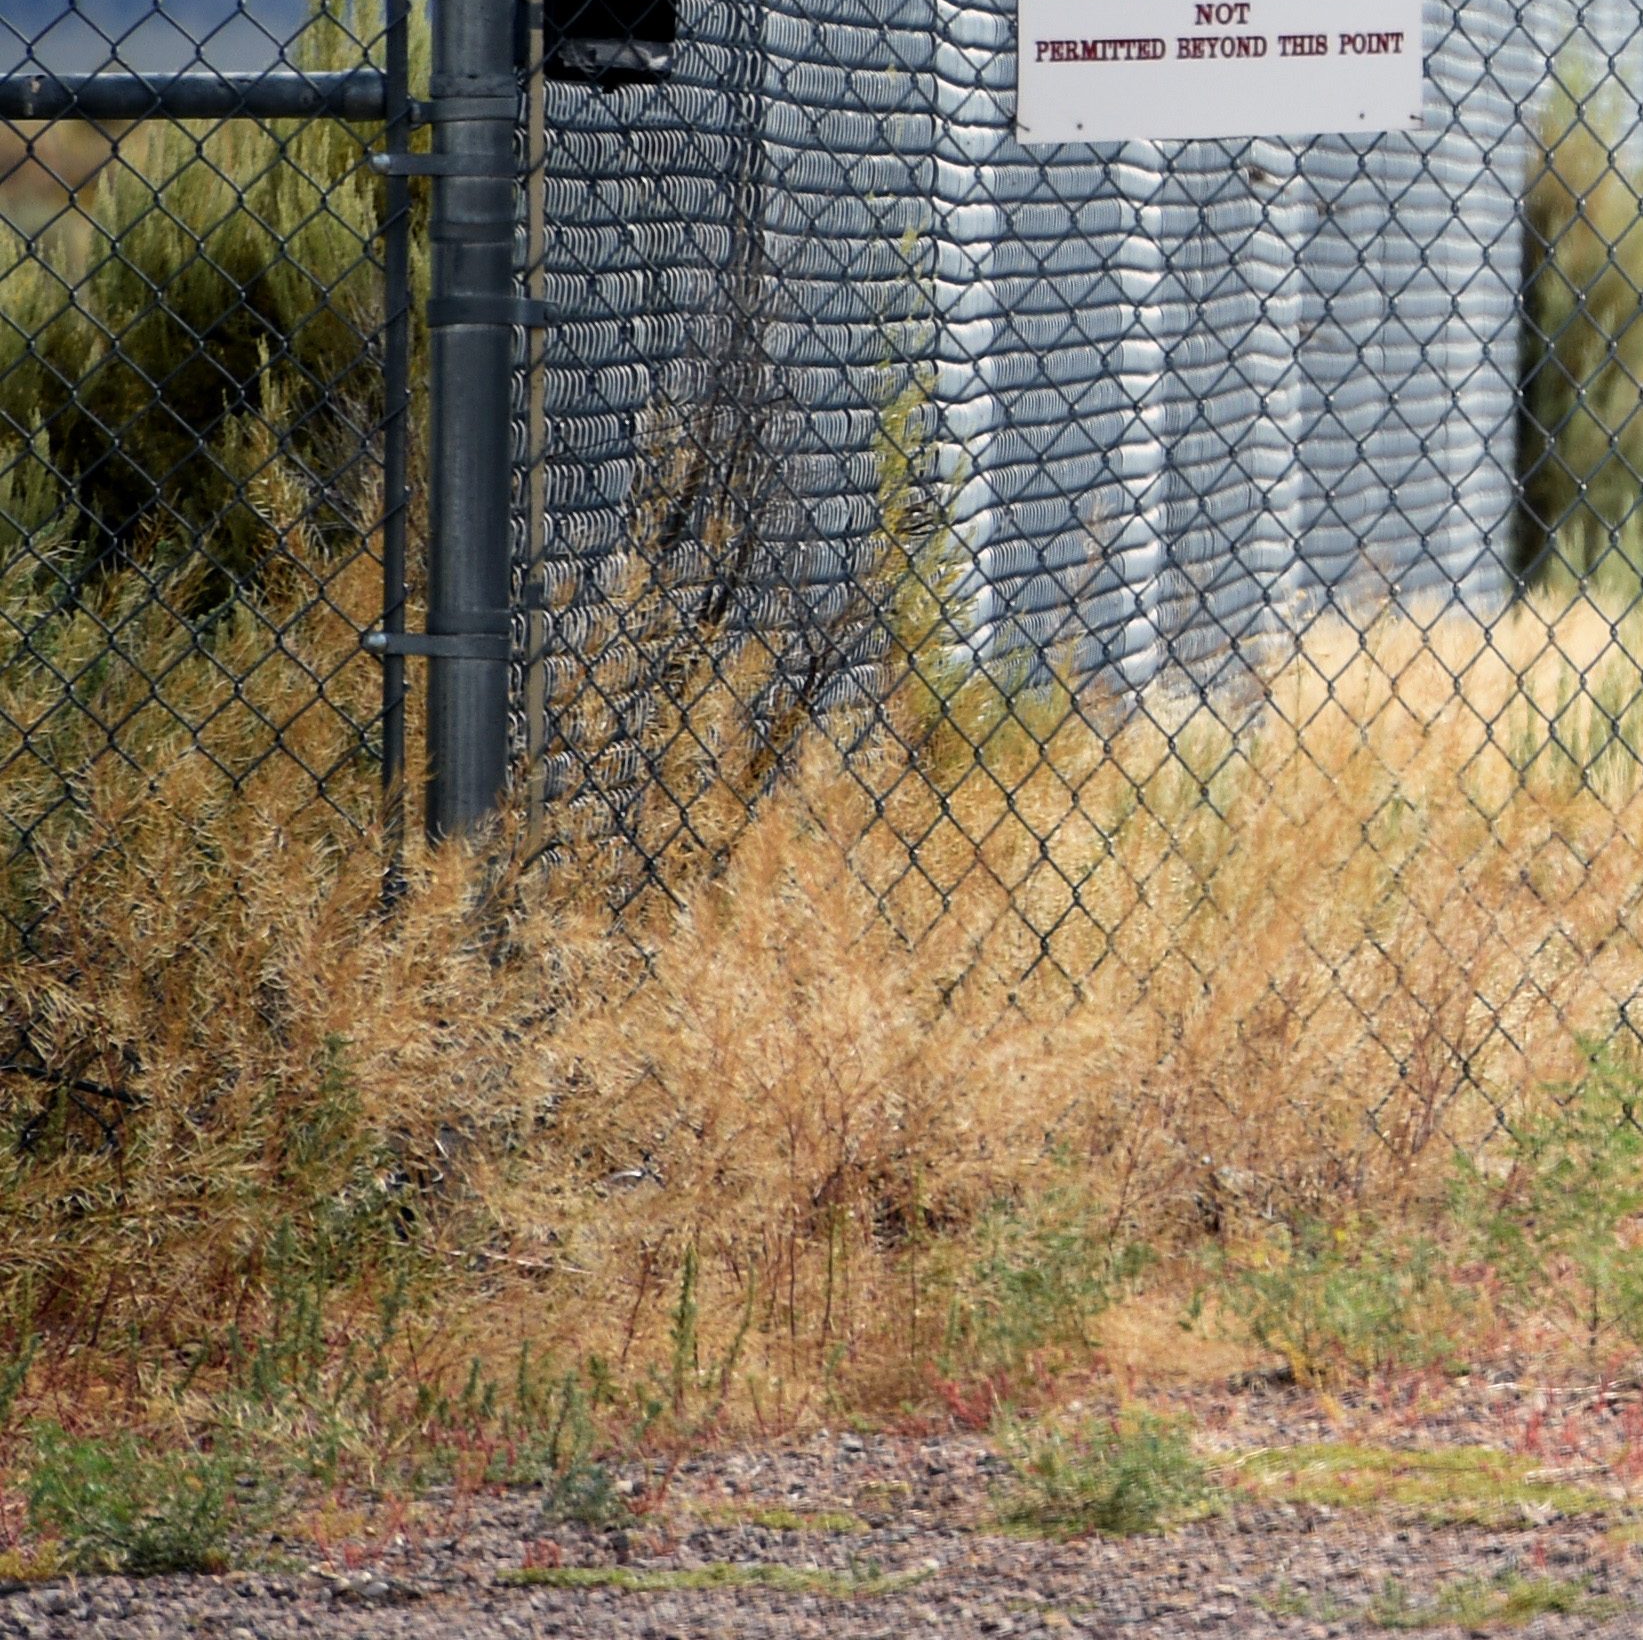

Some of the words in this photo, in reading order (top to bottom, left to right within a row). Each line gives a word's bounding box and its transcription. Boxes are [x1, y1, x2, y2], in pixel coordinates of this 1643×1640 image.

[1194, 3, 1250, 25] NOT
[1035, 37, 1166, 62] PERMITTED
[1176, 35, 1267, 59] BEYOND
[1278, 35, 1328, 57] THIS
[1339, 32, 1404, 56] POINT
